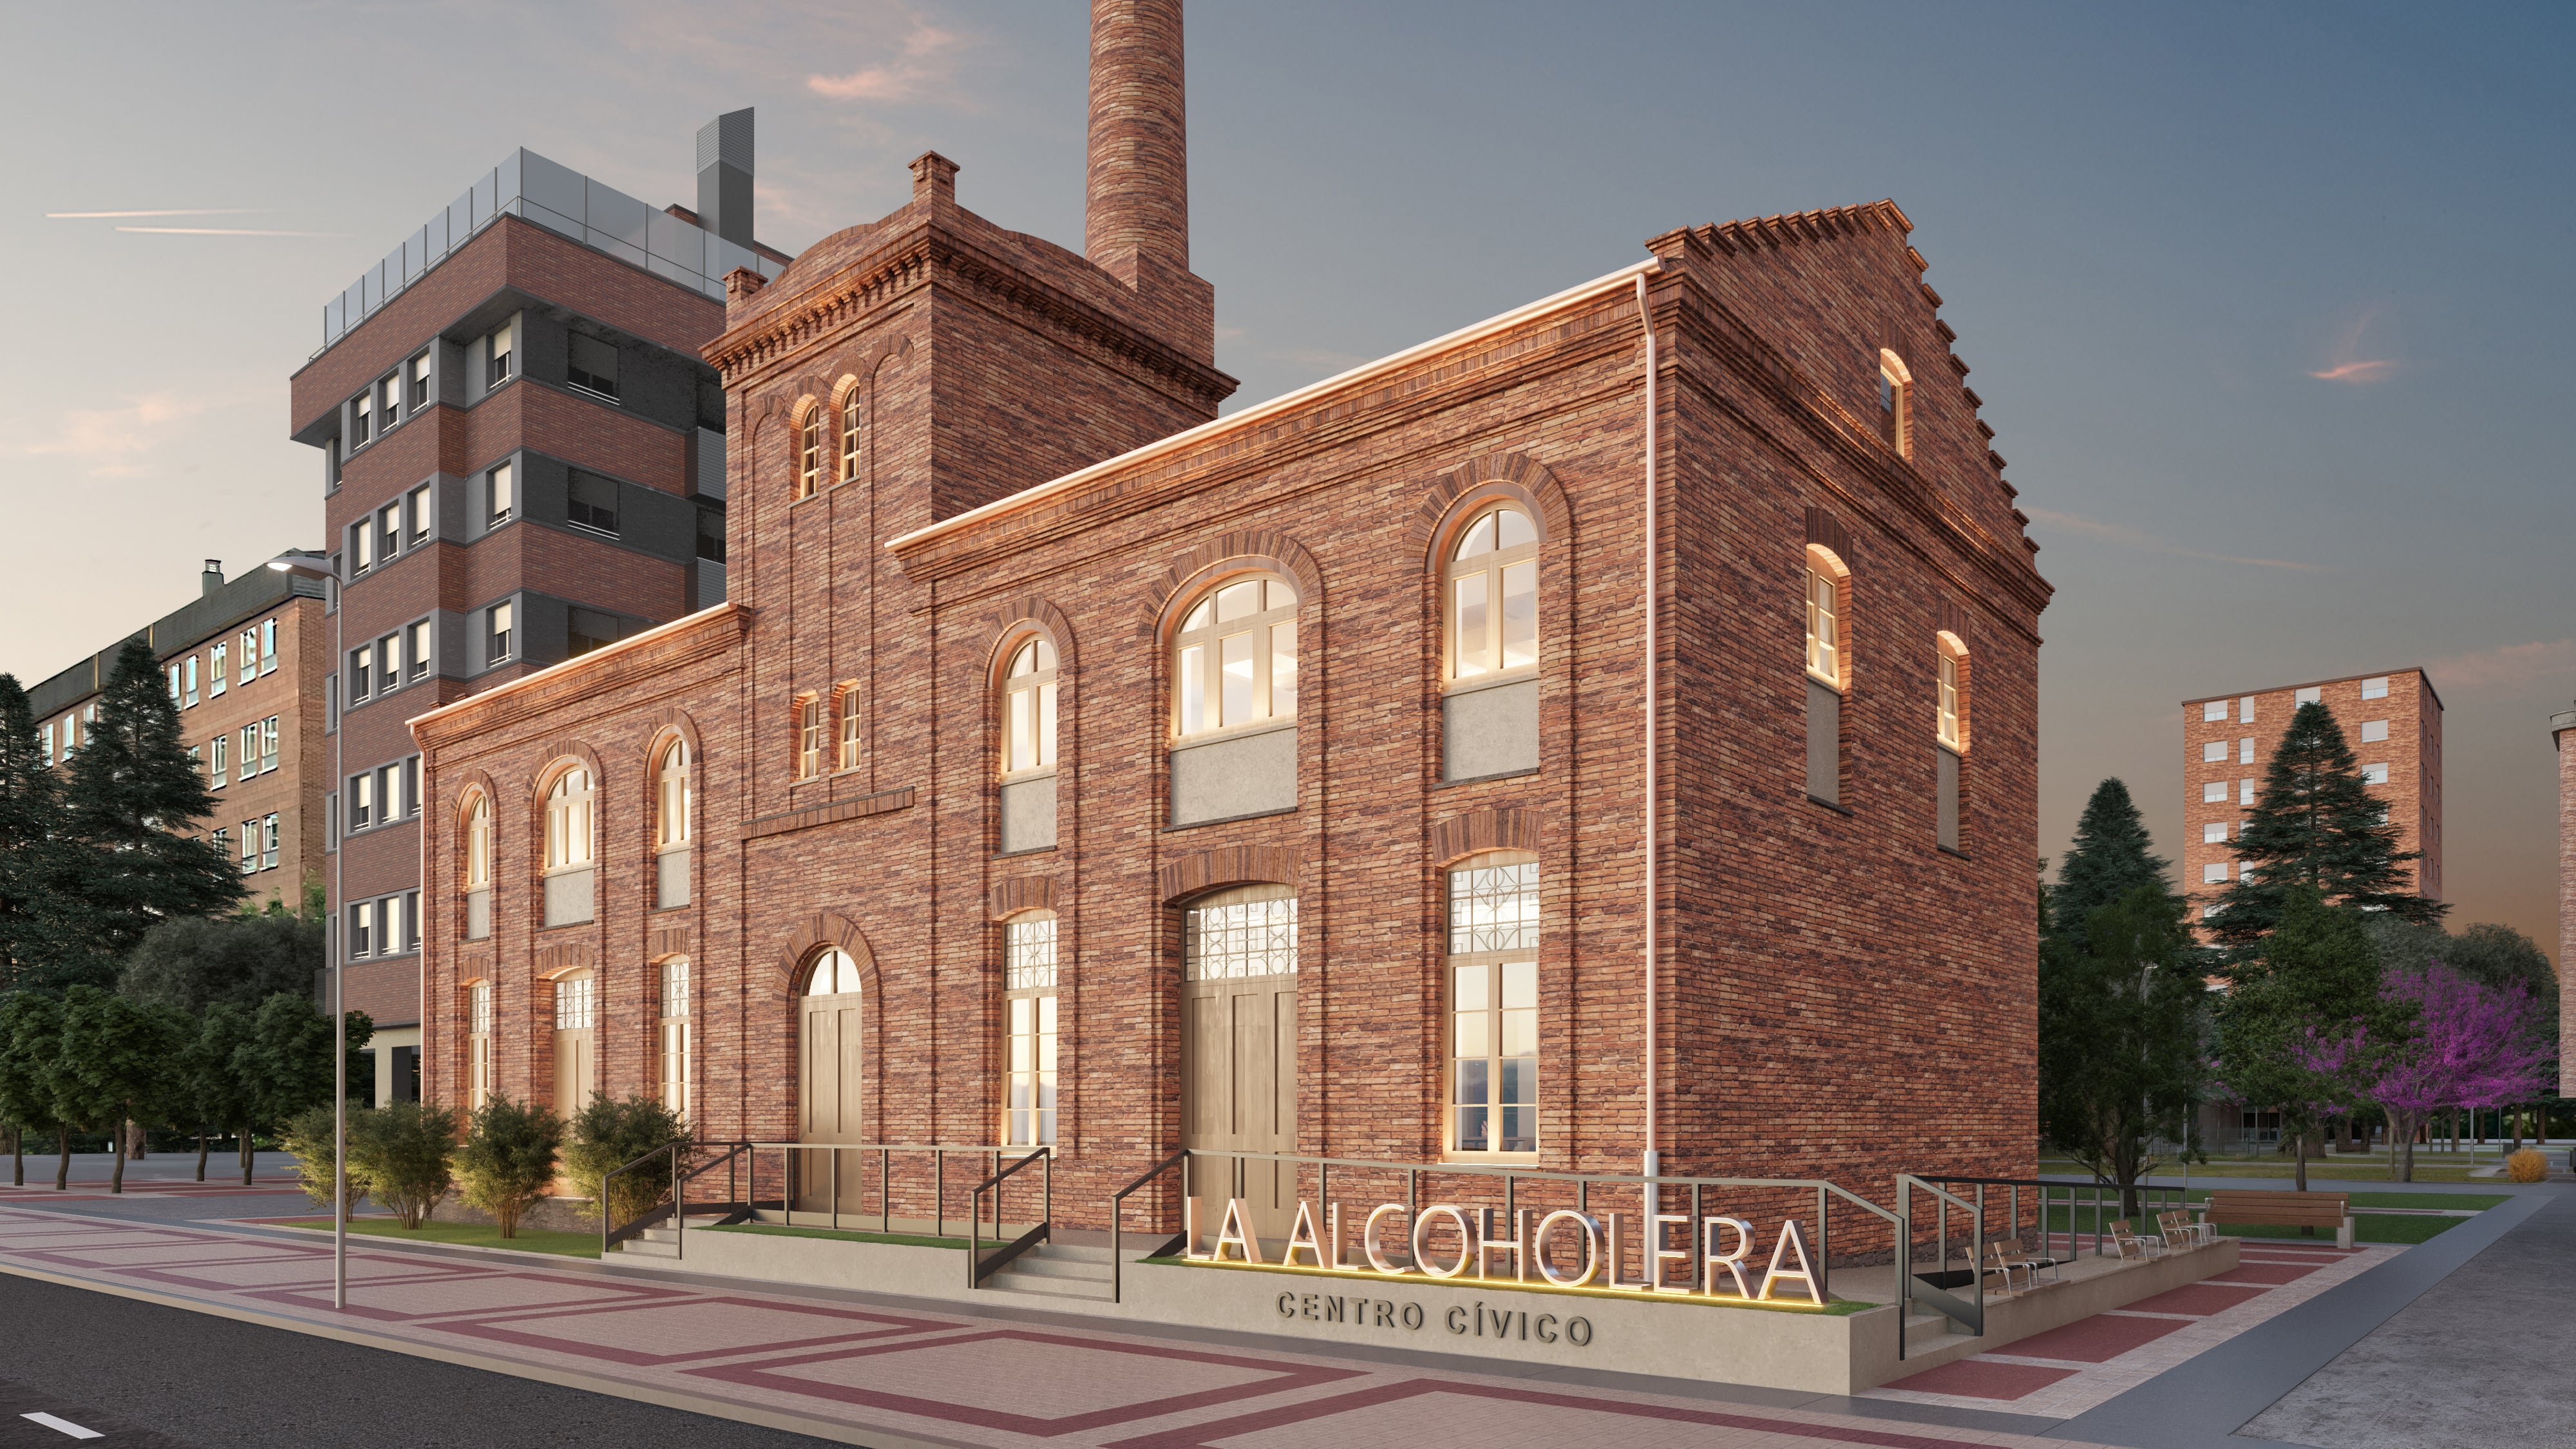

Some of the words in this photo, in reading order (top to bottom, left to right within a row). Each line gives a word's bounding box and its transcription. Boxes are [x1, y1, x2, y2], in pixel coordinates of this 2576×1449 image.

[1187, 1196, 1262, 1264] LA
[1283, 1200, 1829, 1305] ALCOHOLERA
[1275, 1291, 1423, 1331] CENTRO
[1444, 1301, 1592, 1347] CÍVICO
